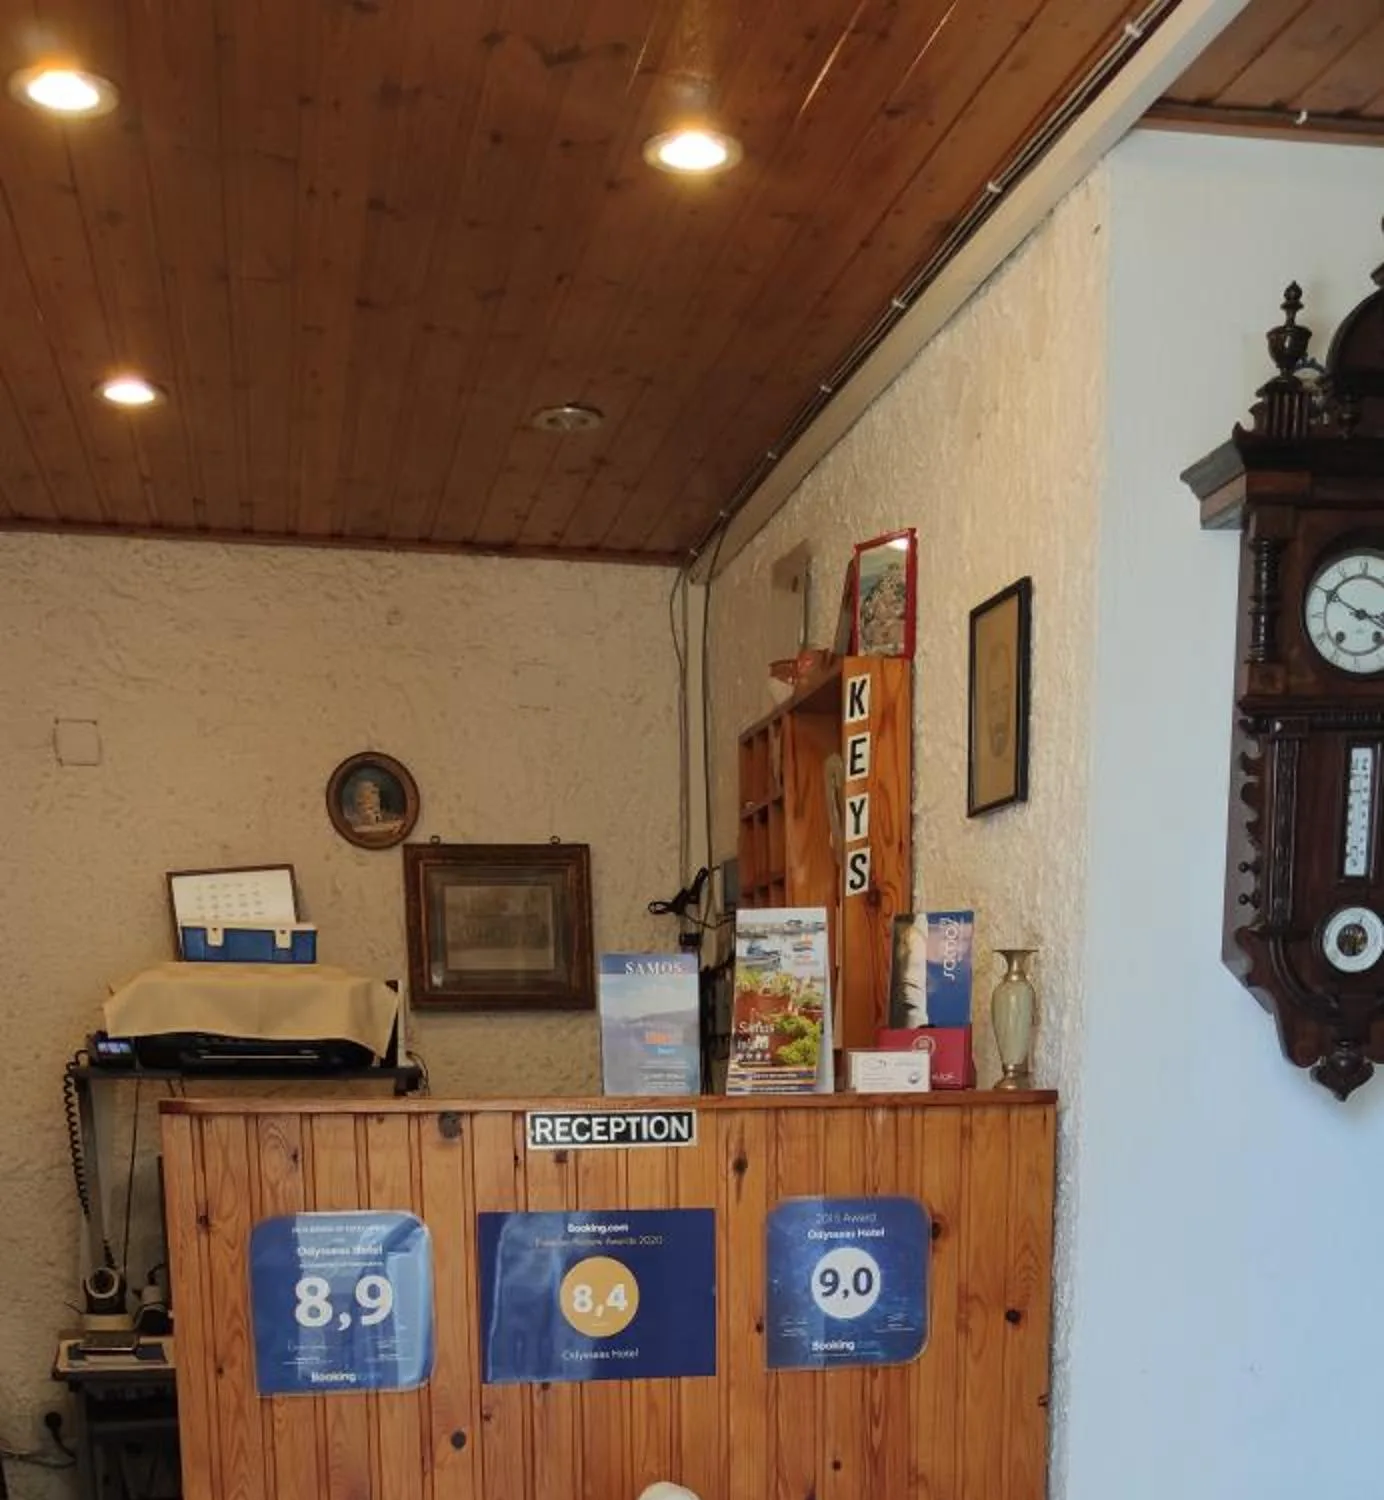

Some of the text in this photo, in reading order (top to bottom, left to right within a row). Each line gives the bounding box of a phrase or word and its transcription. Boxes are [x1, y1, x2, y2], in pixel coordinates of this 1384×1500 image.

[849, 678, 867, 891] KEYS
[624, 961, 684, 976] SAMOS
[534, 1115, 690, 1143] RECEPTION
[567, 1223, 629, 1235] Booking.com
[639, 1234, 663, 1245] 2020
[857, 1226, 885, 1237] Hotel
[819, 1267, 874, 1299] 9,0
[295, 1275, 393, 1331] 8,9
[572, 1283, 629, 1318] 8,4
[611, 1346, 639, 1359] Hotel
